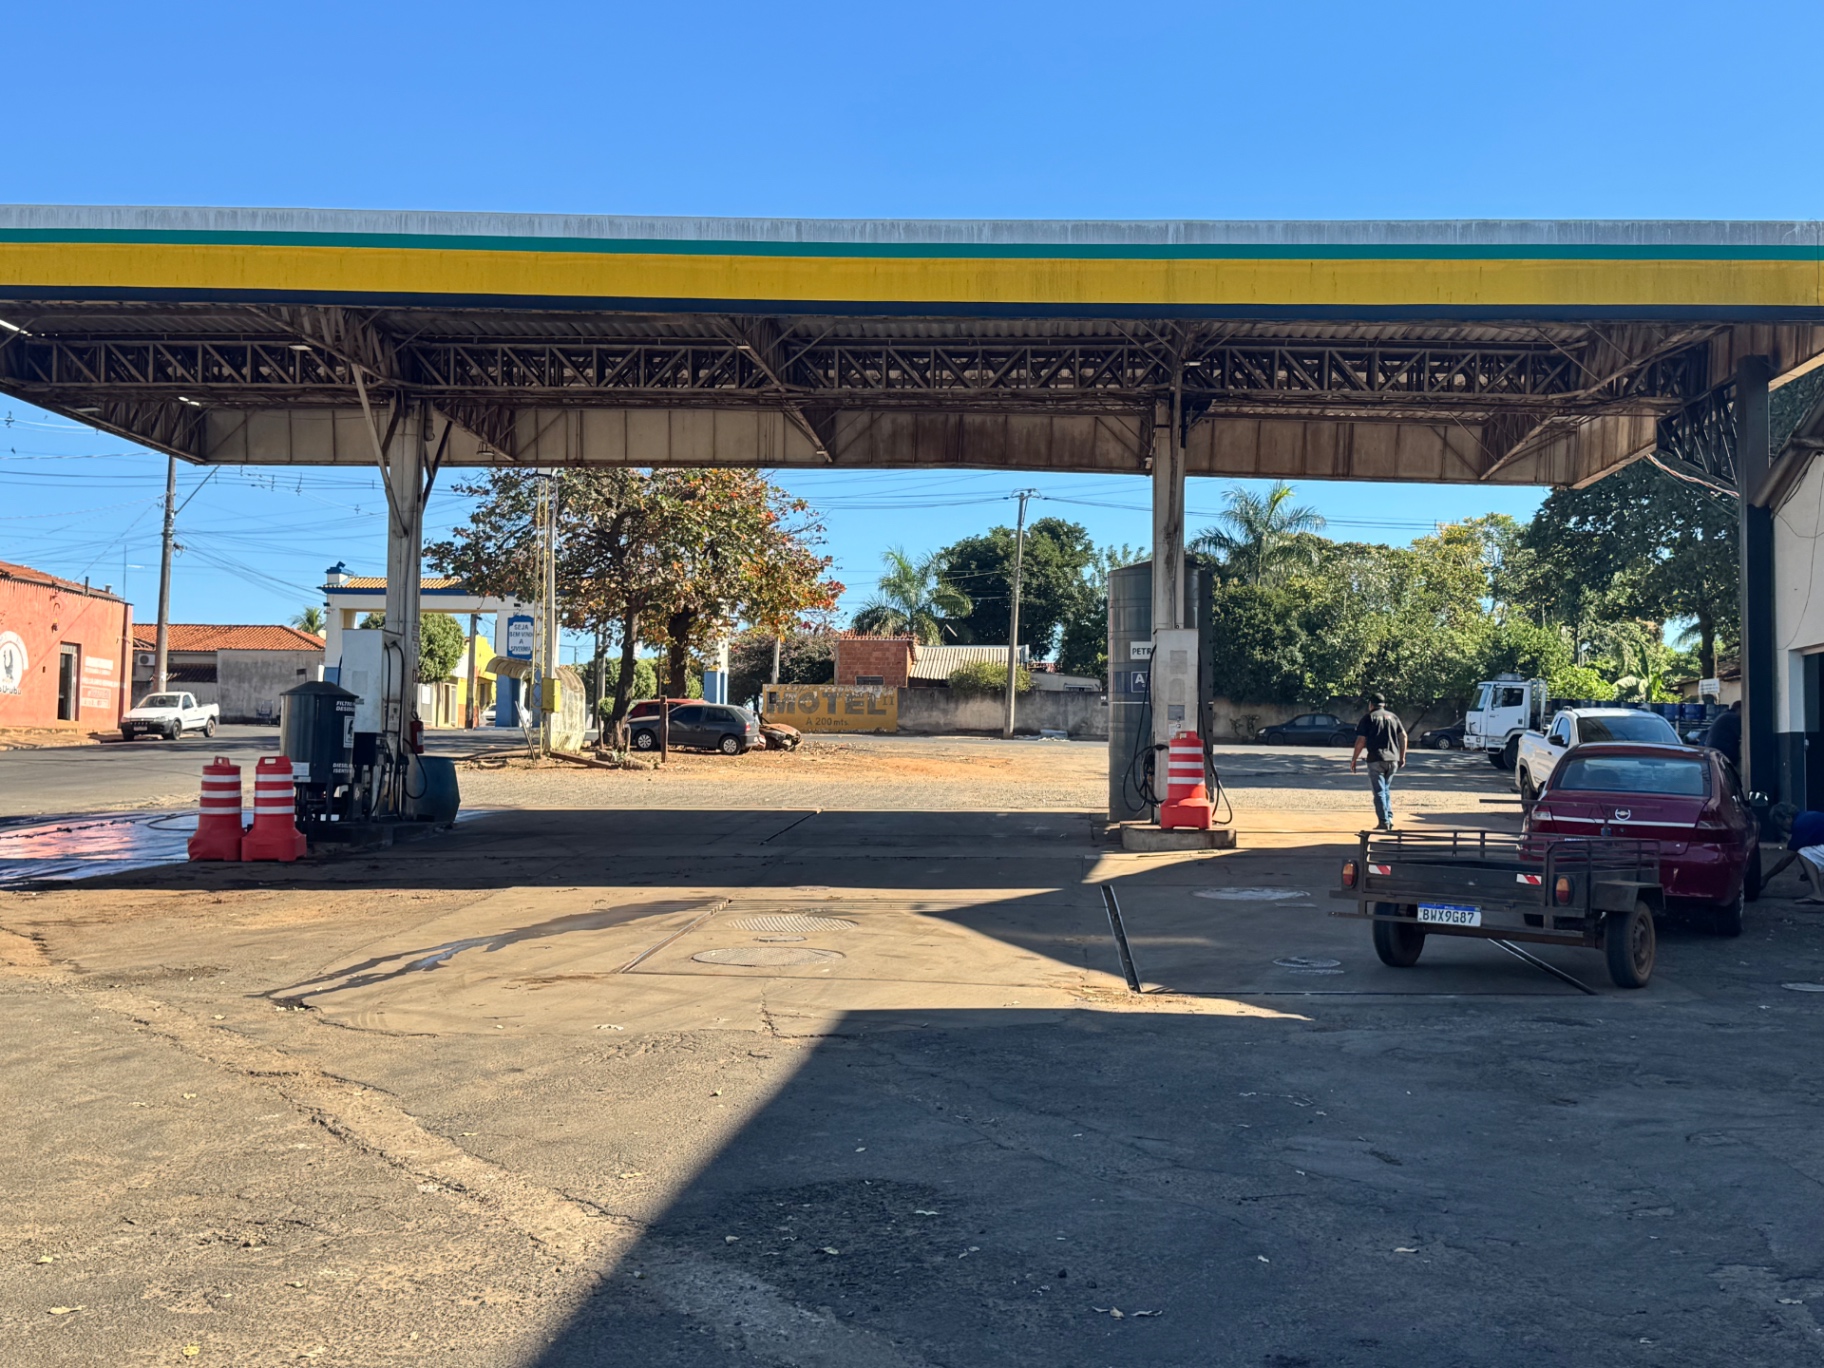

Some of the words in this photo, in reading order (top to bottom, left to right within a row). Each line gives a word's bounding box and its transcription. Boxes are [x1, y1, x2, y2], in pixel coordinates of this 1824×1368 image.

[766, 691, 886, 715] MOTEL
[805, 717, 813, 726] A
[815, 717, 832, 726] 200
[1422, 909, 1475, 924] BWX9G87
